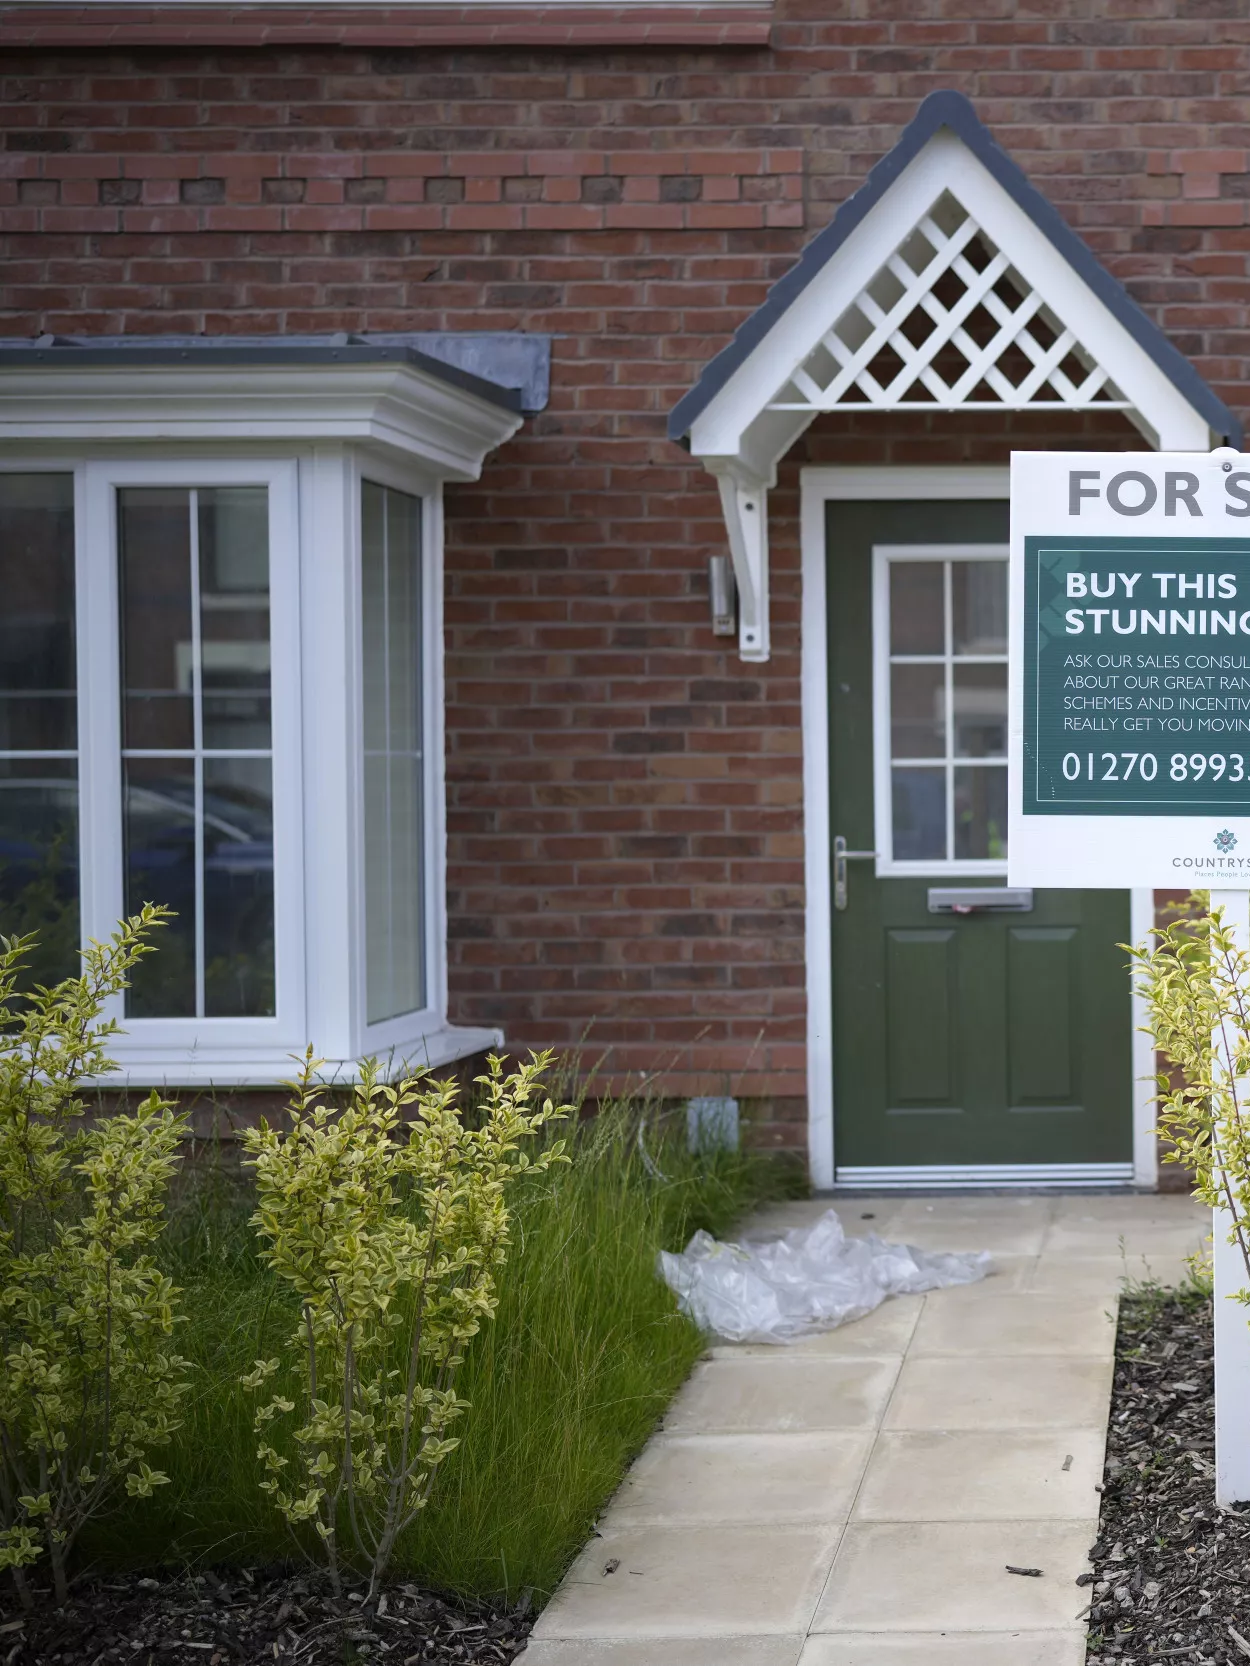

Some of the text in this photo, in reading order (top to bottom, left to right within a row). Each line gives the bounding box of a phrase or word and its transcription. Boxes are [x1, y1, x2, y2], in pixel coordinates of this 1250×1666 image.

[1069, 471, 1204, 517] FOR
[1066, 572, 1238, 599] BUY THIS
[1063, 654, 1093, 668] ASK
[1096, 654, 1133, 668] OUR
[1136, 654, 1180, 669] SALES
[1063, 675, 1120, 689] ABOUT
[1124, 675, 1160, 690] OUR
[1163, 675, 1216, 690] GREAT
[1063, 696, 1133, 710] SCHEMES
[1136, 696, 1174, 710] AND
[1064, 717, 1119, 731] REALLY
[1123, 717, 1154, 731] GET
[1157, 717, 1193, 732] YOU
[1062, 752, 1158, 781] 01270
[1194, 870, 1215, 878] Places
[1216, 870, 1239, 879] People
